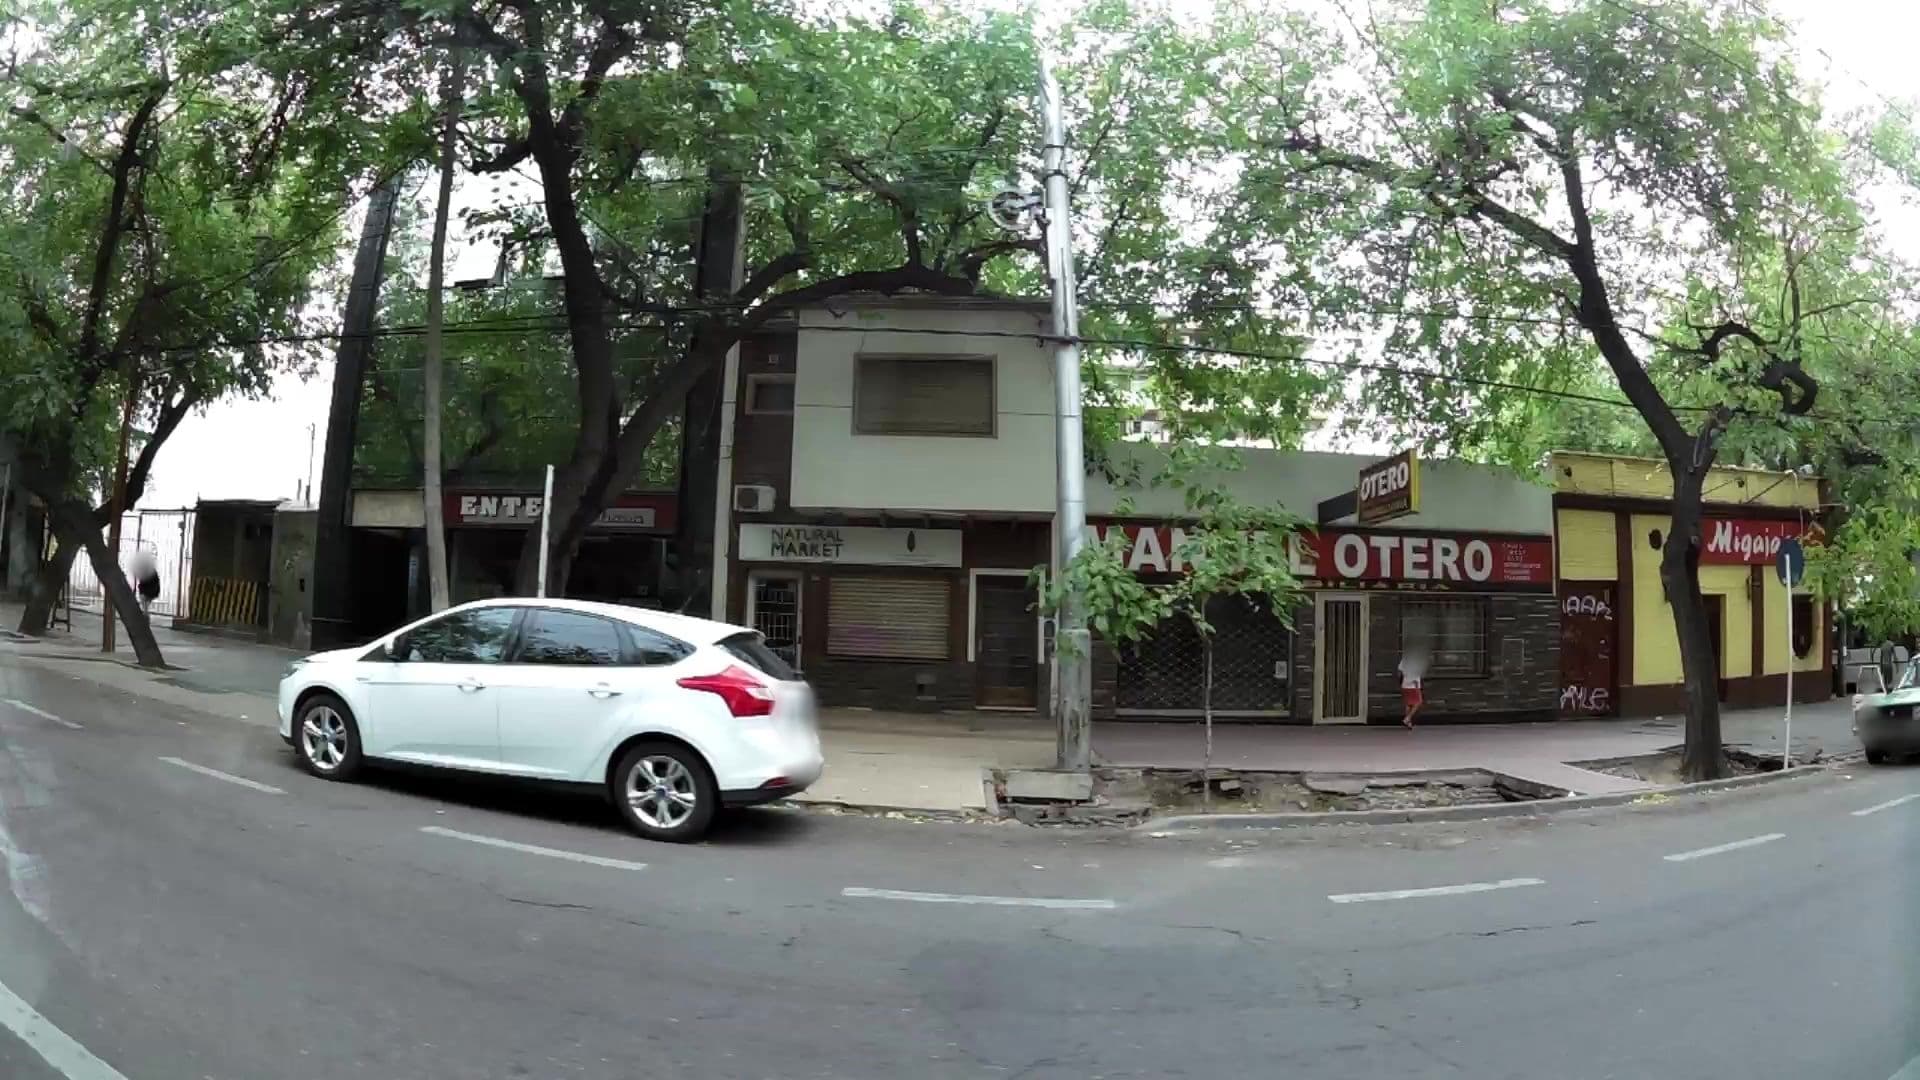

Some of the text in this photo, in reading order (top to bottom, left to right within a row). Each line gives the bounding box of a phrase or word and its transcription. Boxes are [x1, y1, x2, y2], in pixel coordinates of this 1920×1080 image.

[1360, 461, 1409, 501] OTERO
[771, 528, 845, 542] NATURAL
[771, 543, 844, 558] MARKET
[1334, 533, 1493, 582] OTERO
